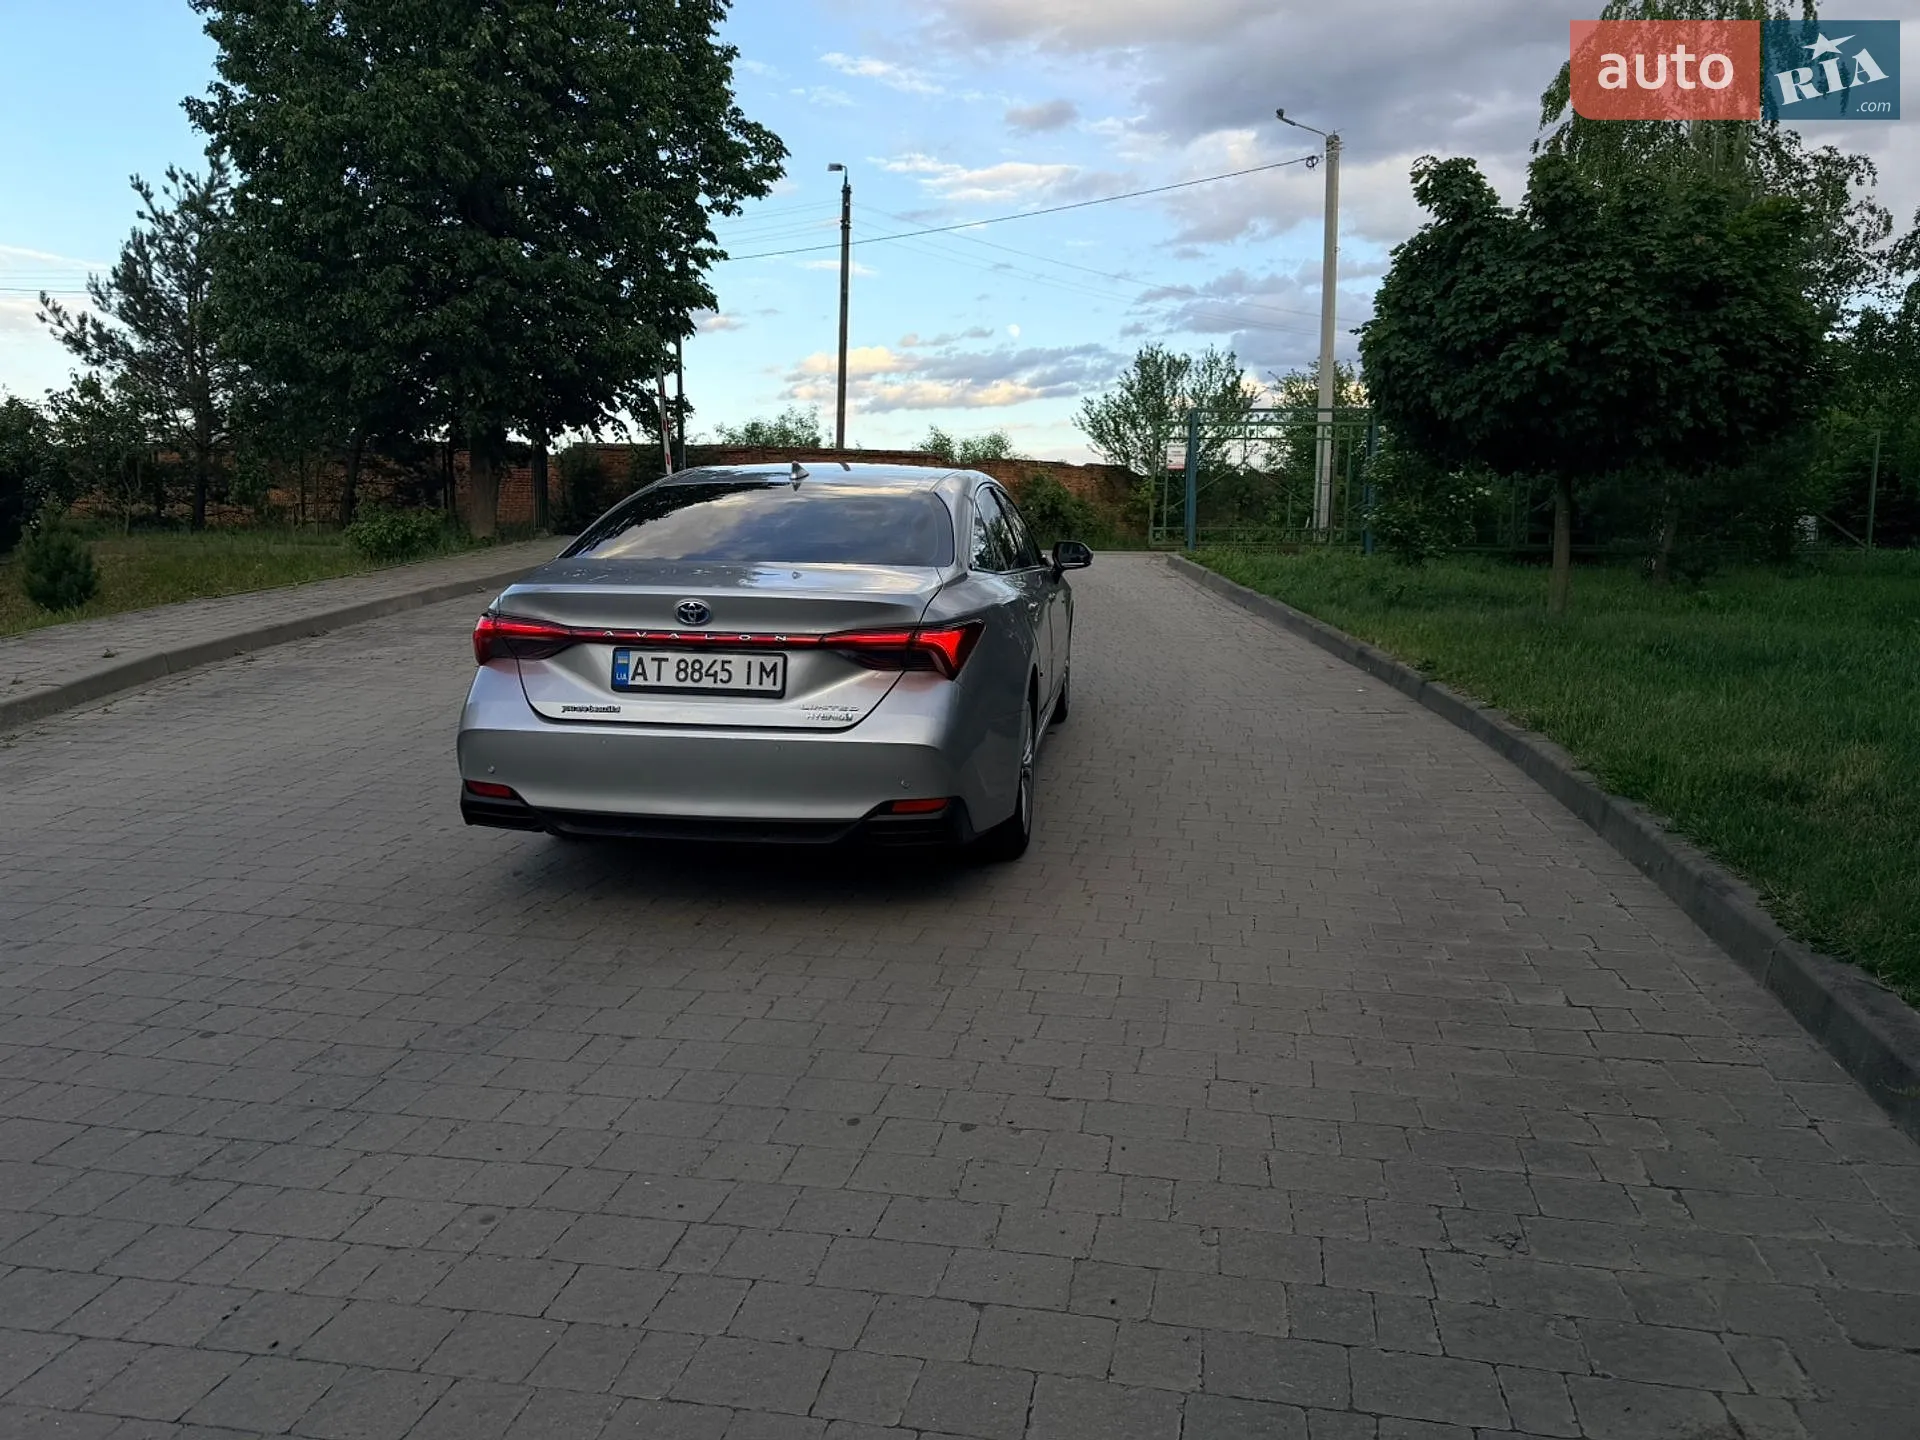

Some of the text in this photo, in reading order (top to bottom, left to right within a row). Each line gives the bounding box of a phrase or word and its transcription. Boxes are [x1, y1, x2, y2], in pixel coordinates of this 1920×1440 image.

[602, 630, 787, 641] AVALON
[630, 656, 778, 687] AT 8845 IM
